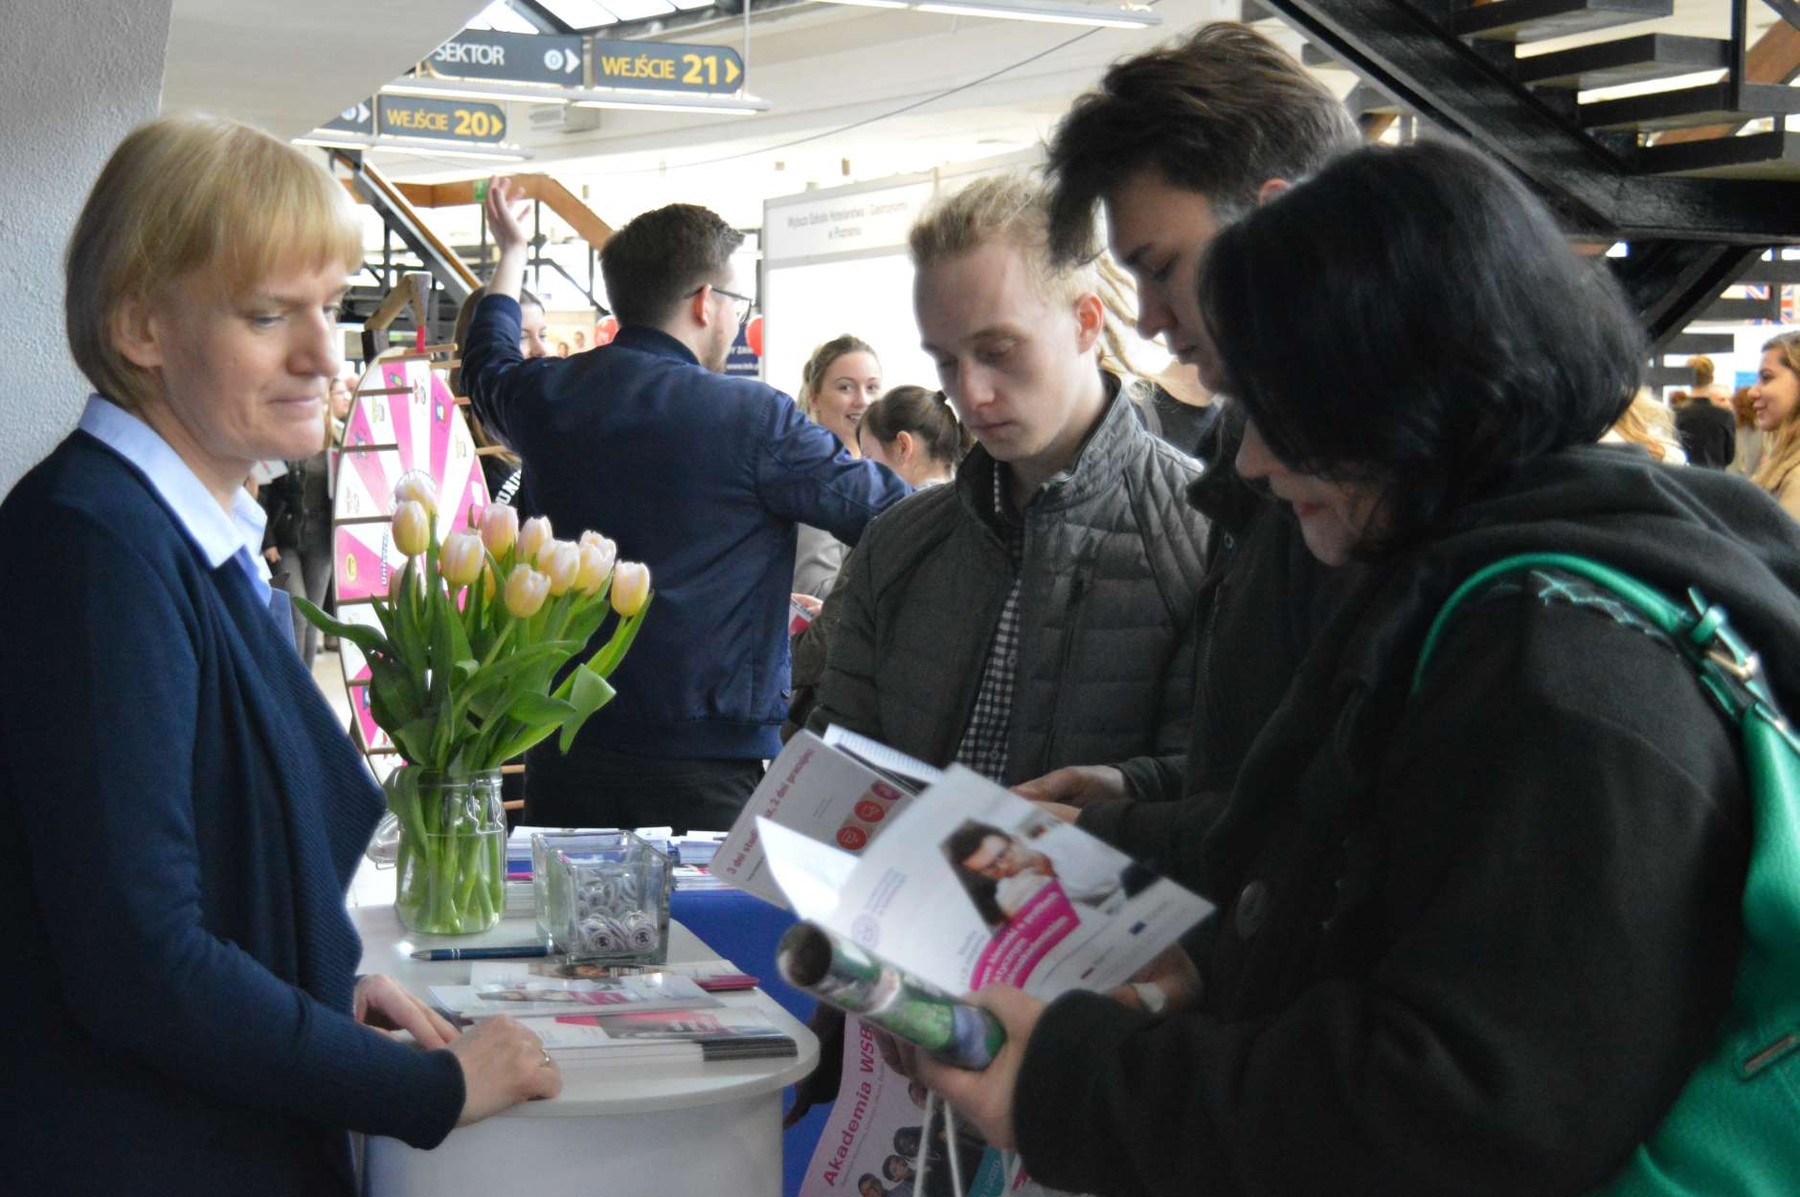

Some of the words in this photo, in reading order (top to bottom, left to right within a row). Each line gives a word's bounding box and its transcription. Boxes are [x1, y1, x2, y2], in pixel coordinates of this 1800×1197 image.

[435, 42, 505, 65] SEKTOR
[601, 54, 676, 79] WEJŚCIE
[682, 53, 718, 85] 21
[387, 107, 449, 131] WEJŚCIE
[454, 109, 489, 137] 20
[823, 1081, 872, 1186] Akademia
[859, 1027, 874, 1073] WSB
